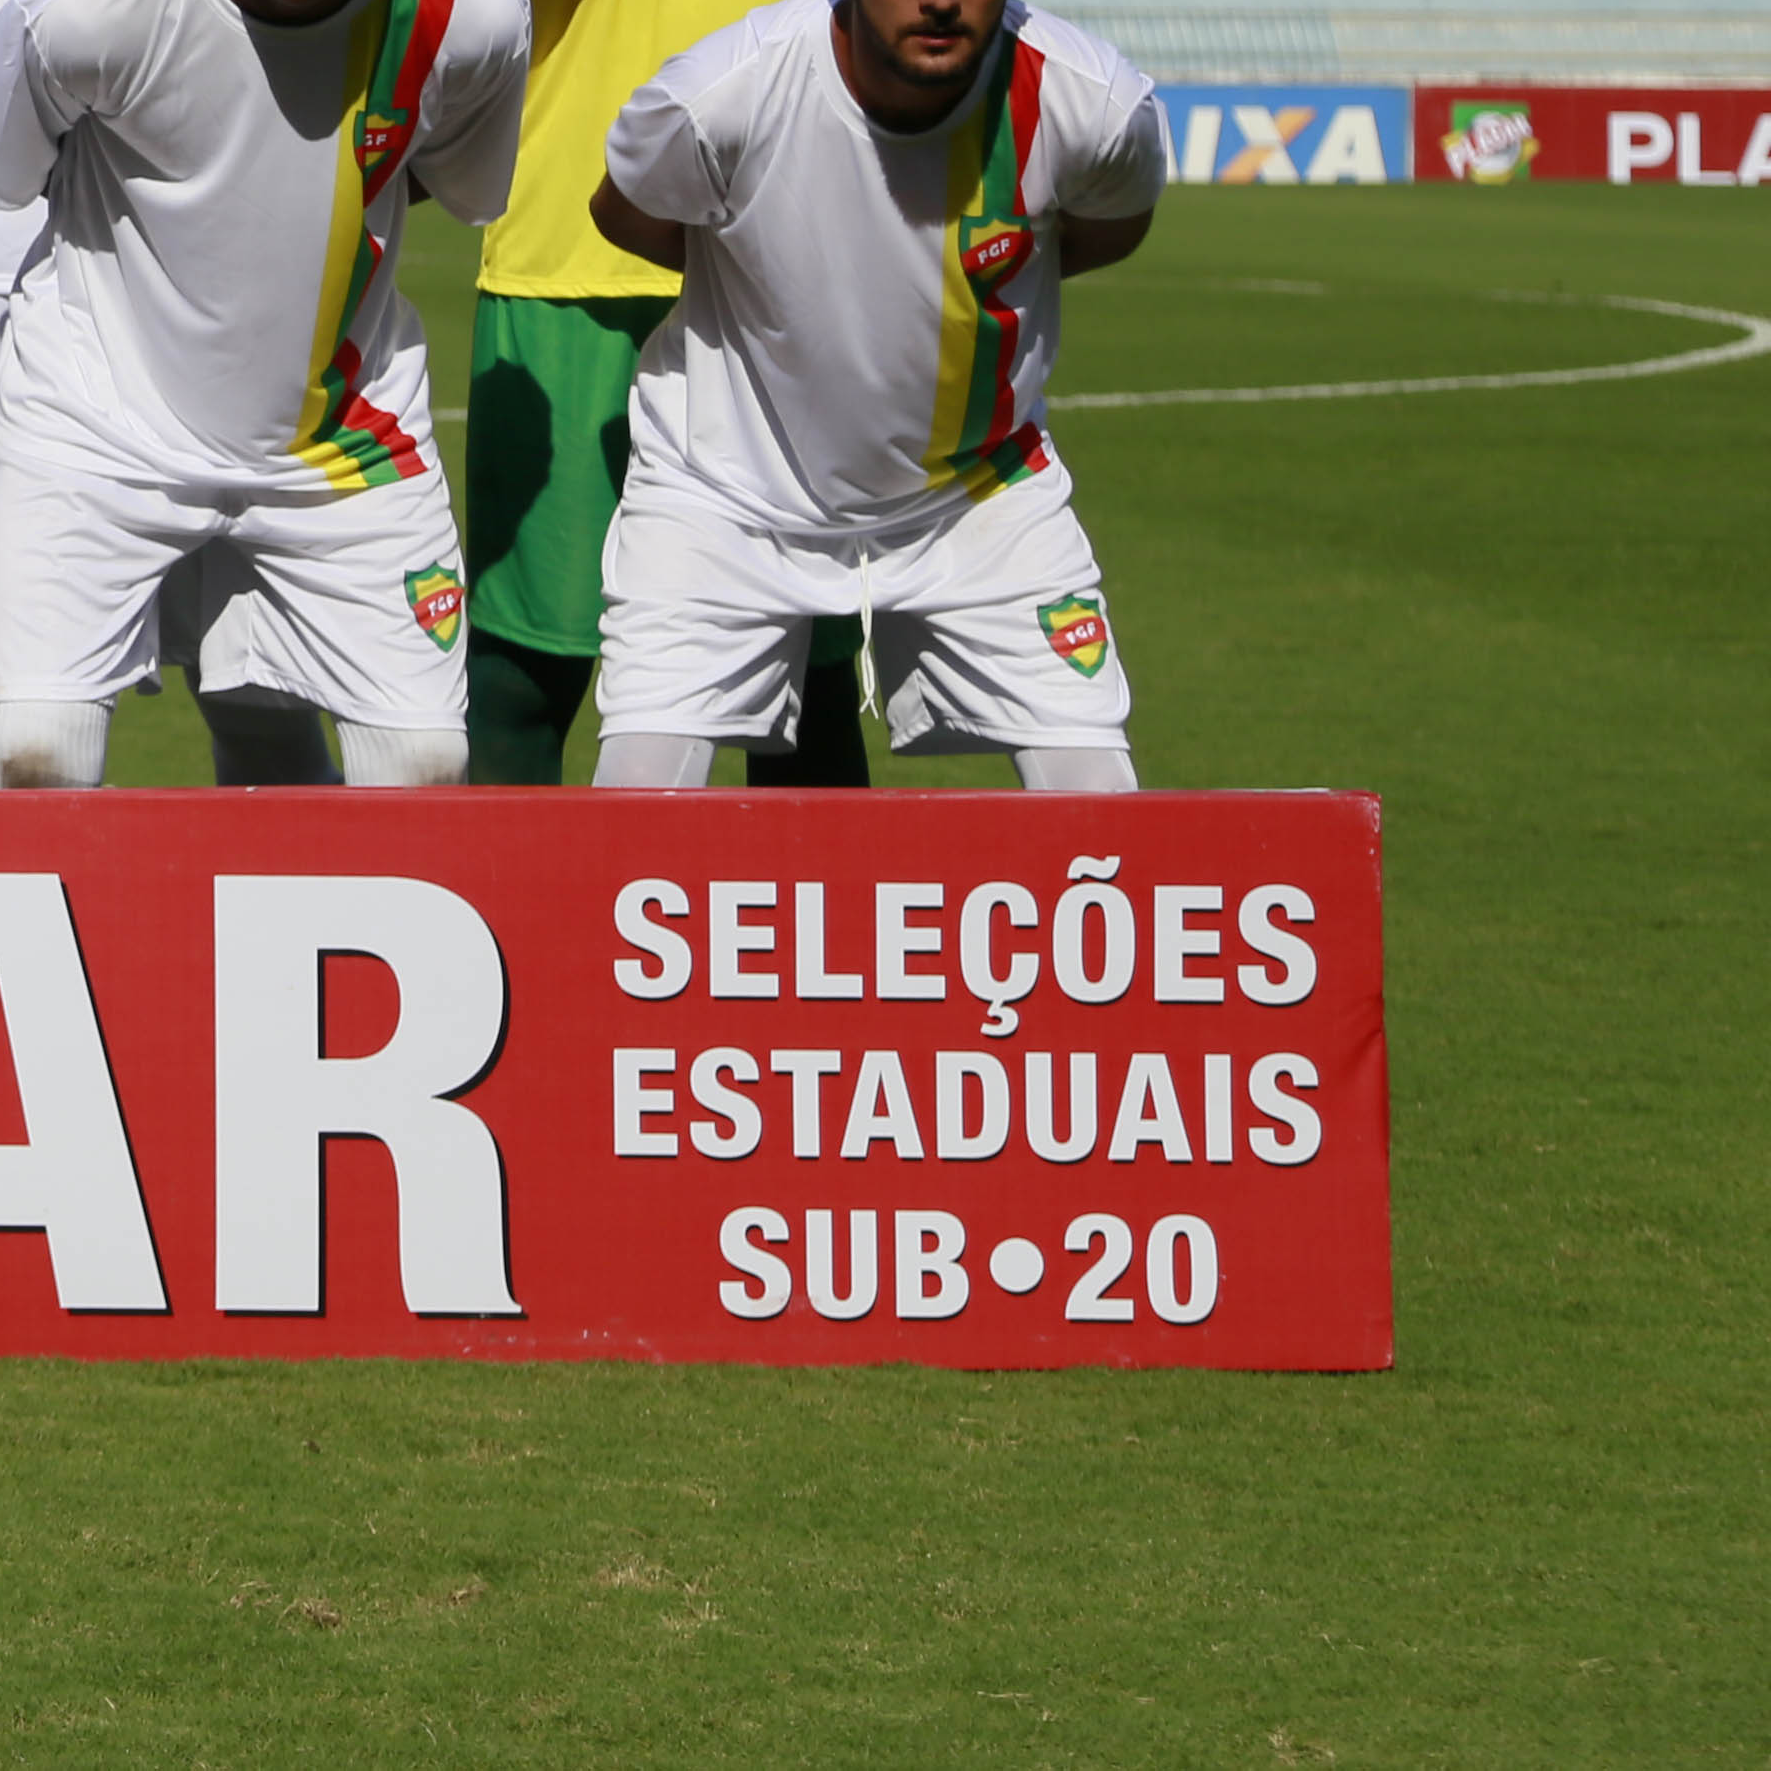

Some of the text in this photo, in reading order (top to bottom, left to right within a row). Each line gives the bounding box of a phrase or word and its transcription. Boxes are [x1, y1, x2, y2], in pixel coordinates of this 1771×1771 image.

[977, 237, 1011, 265] FGF
[614, 855, 1317, 1037] SELEÇÕES
[613, 1047, 1323, 1165] ESTADUAIS
